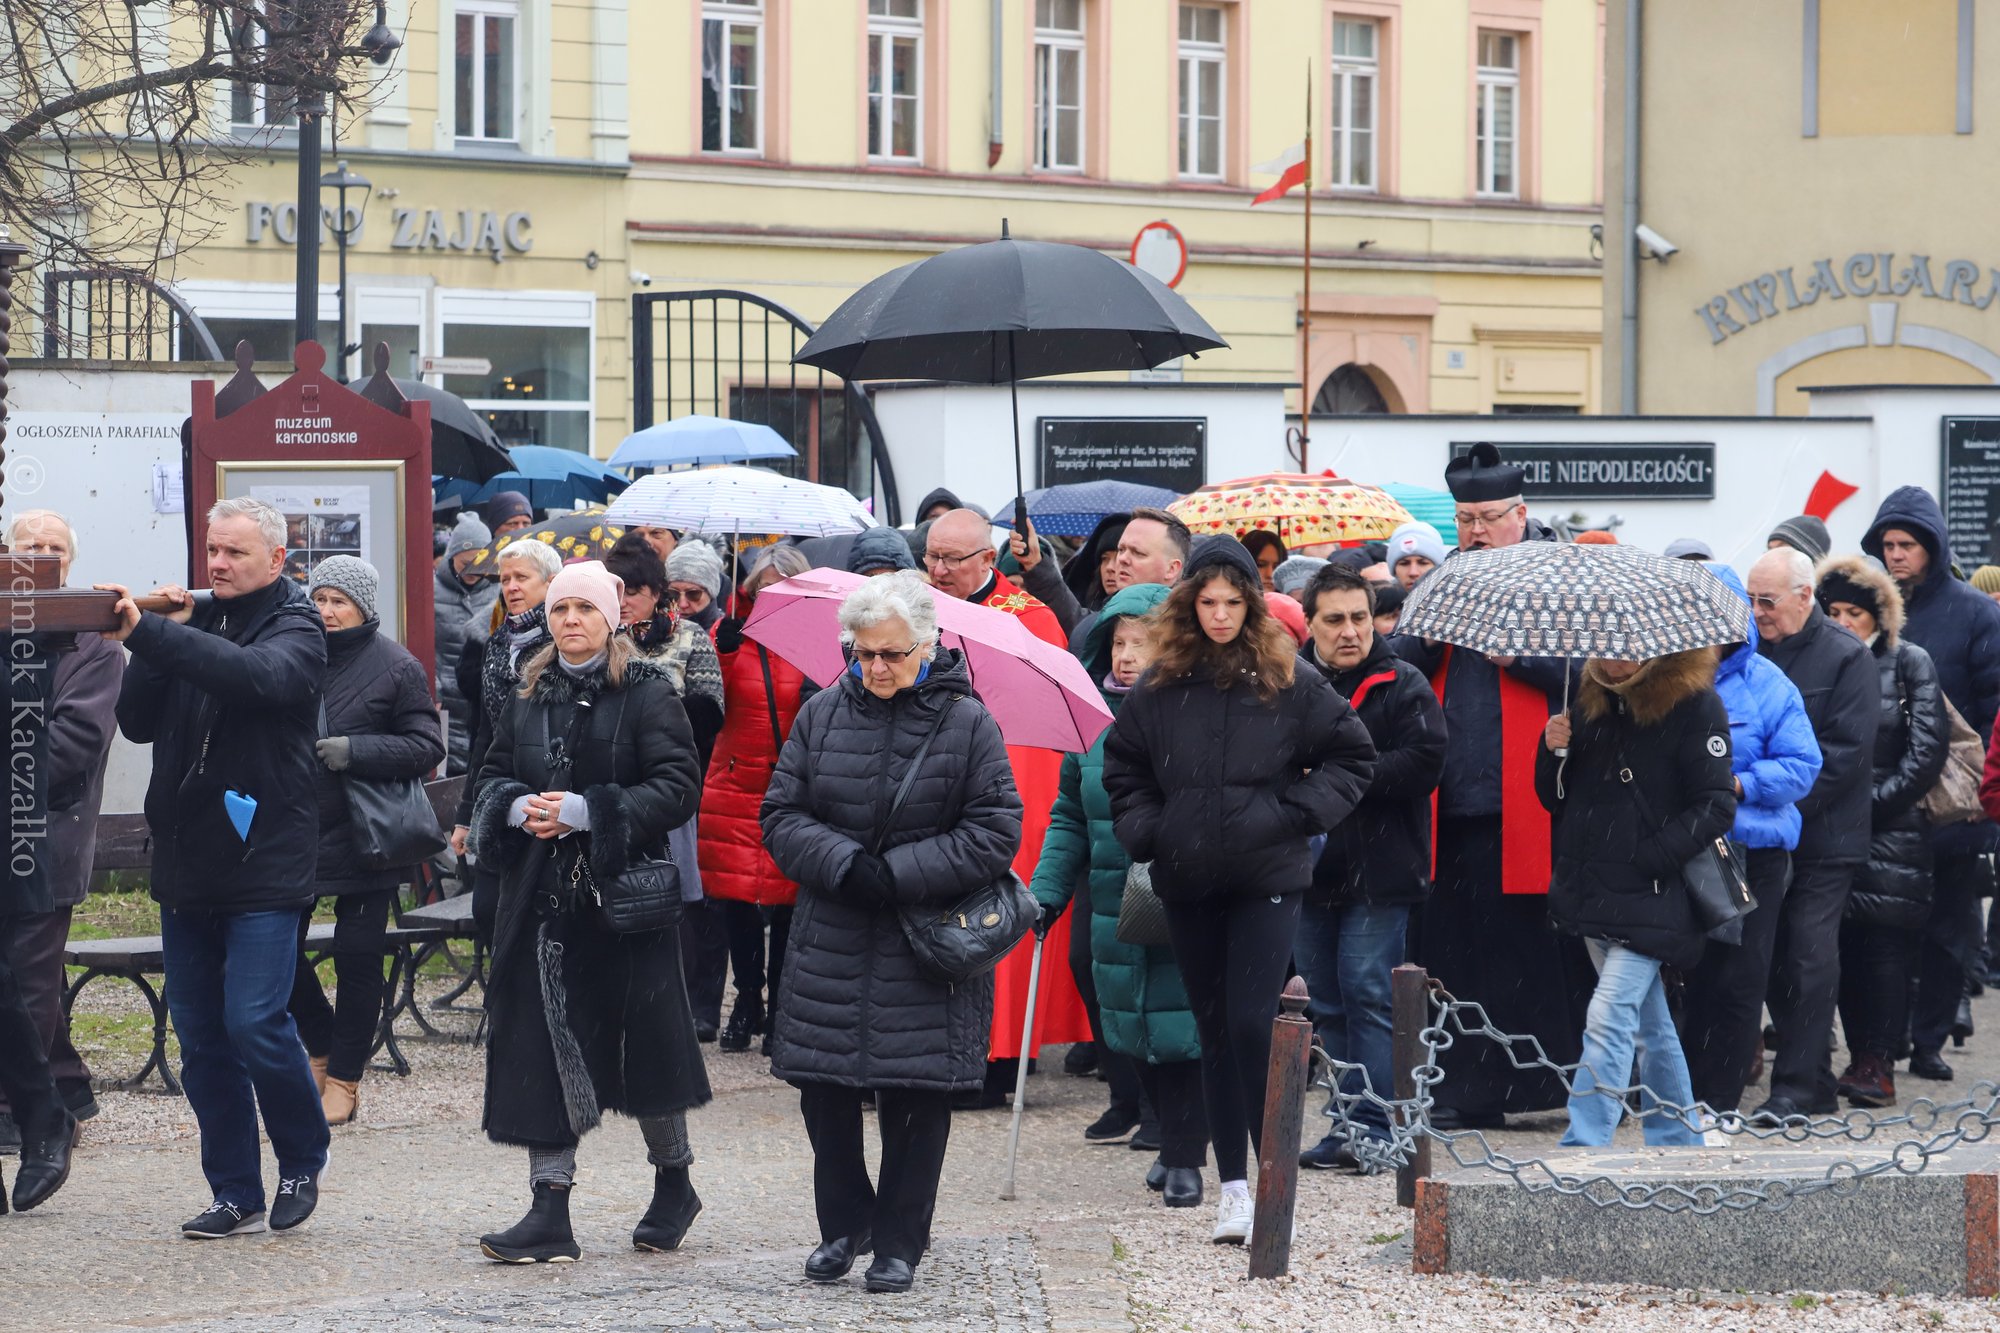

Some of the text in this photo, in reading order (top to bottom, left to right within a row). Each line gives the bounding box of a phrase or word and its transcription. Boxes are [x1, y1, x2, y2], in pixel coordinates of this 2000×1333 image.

[391, 207, 534, 264] ZAJĄC
[275, 417, 332, 429] muzeum
[16, 425, 182, 439] OGŁOSZENIA PARAFIALN
[275, 431, 358, 444] karkonoskie
[1556, 454, 1705, 484] NIEPODLEGŁOŚCI
[1712, 742, 1723, 751] M
[641, 876, 657, 888] CK
